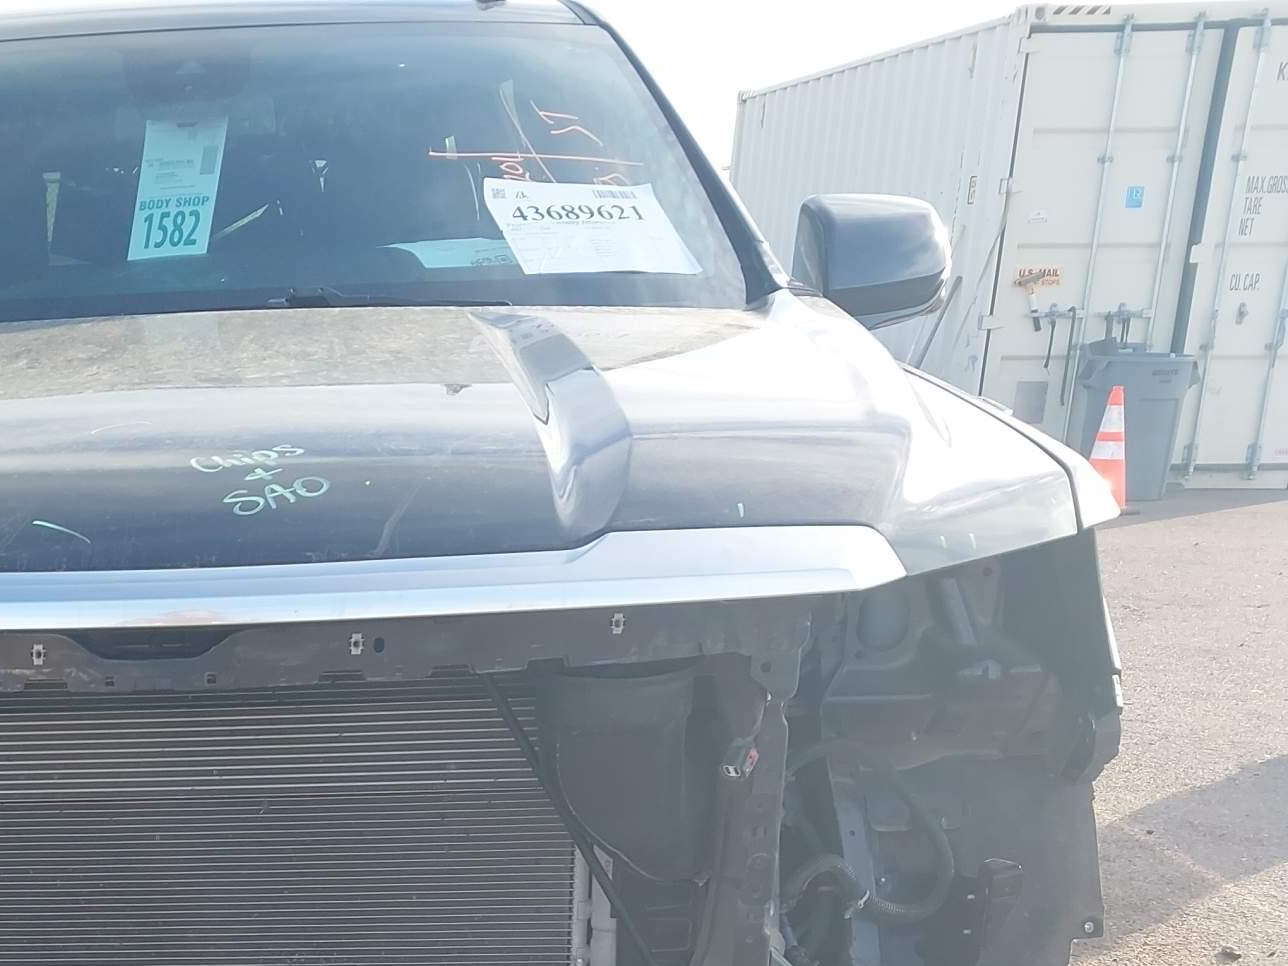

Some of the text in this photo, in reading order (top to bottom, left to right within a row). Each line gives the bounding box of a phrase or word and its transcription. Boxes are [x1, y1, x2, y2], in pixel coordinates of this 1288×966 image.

[139, 195, 210, 211] BODY SHOP
[1242, 197, 1262, 215] TARE
[512, 204, 645, 221] 43689621
[143, 209, 201, 249] 1582
[1238, 218, 1255, 236] NET
